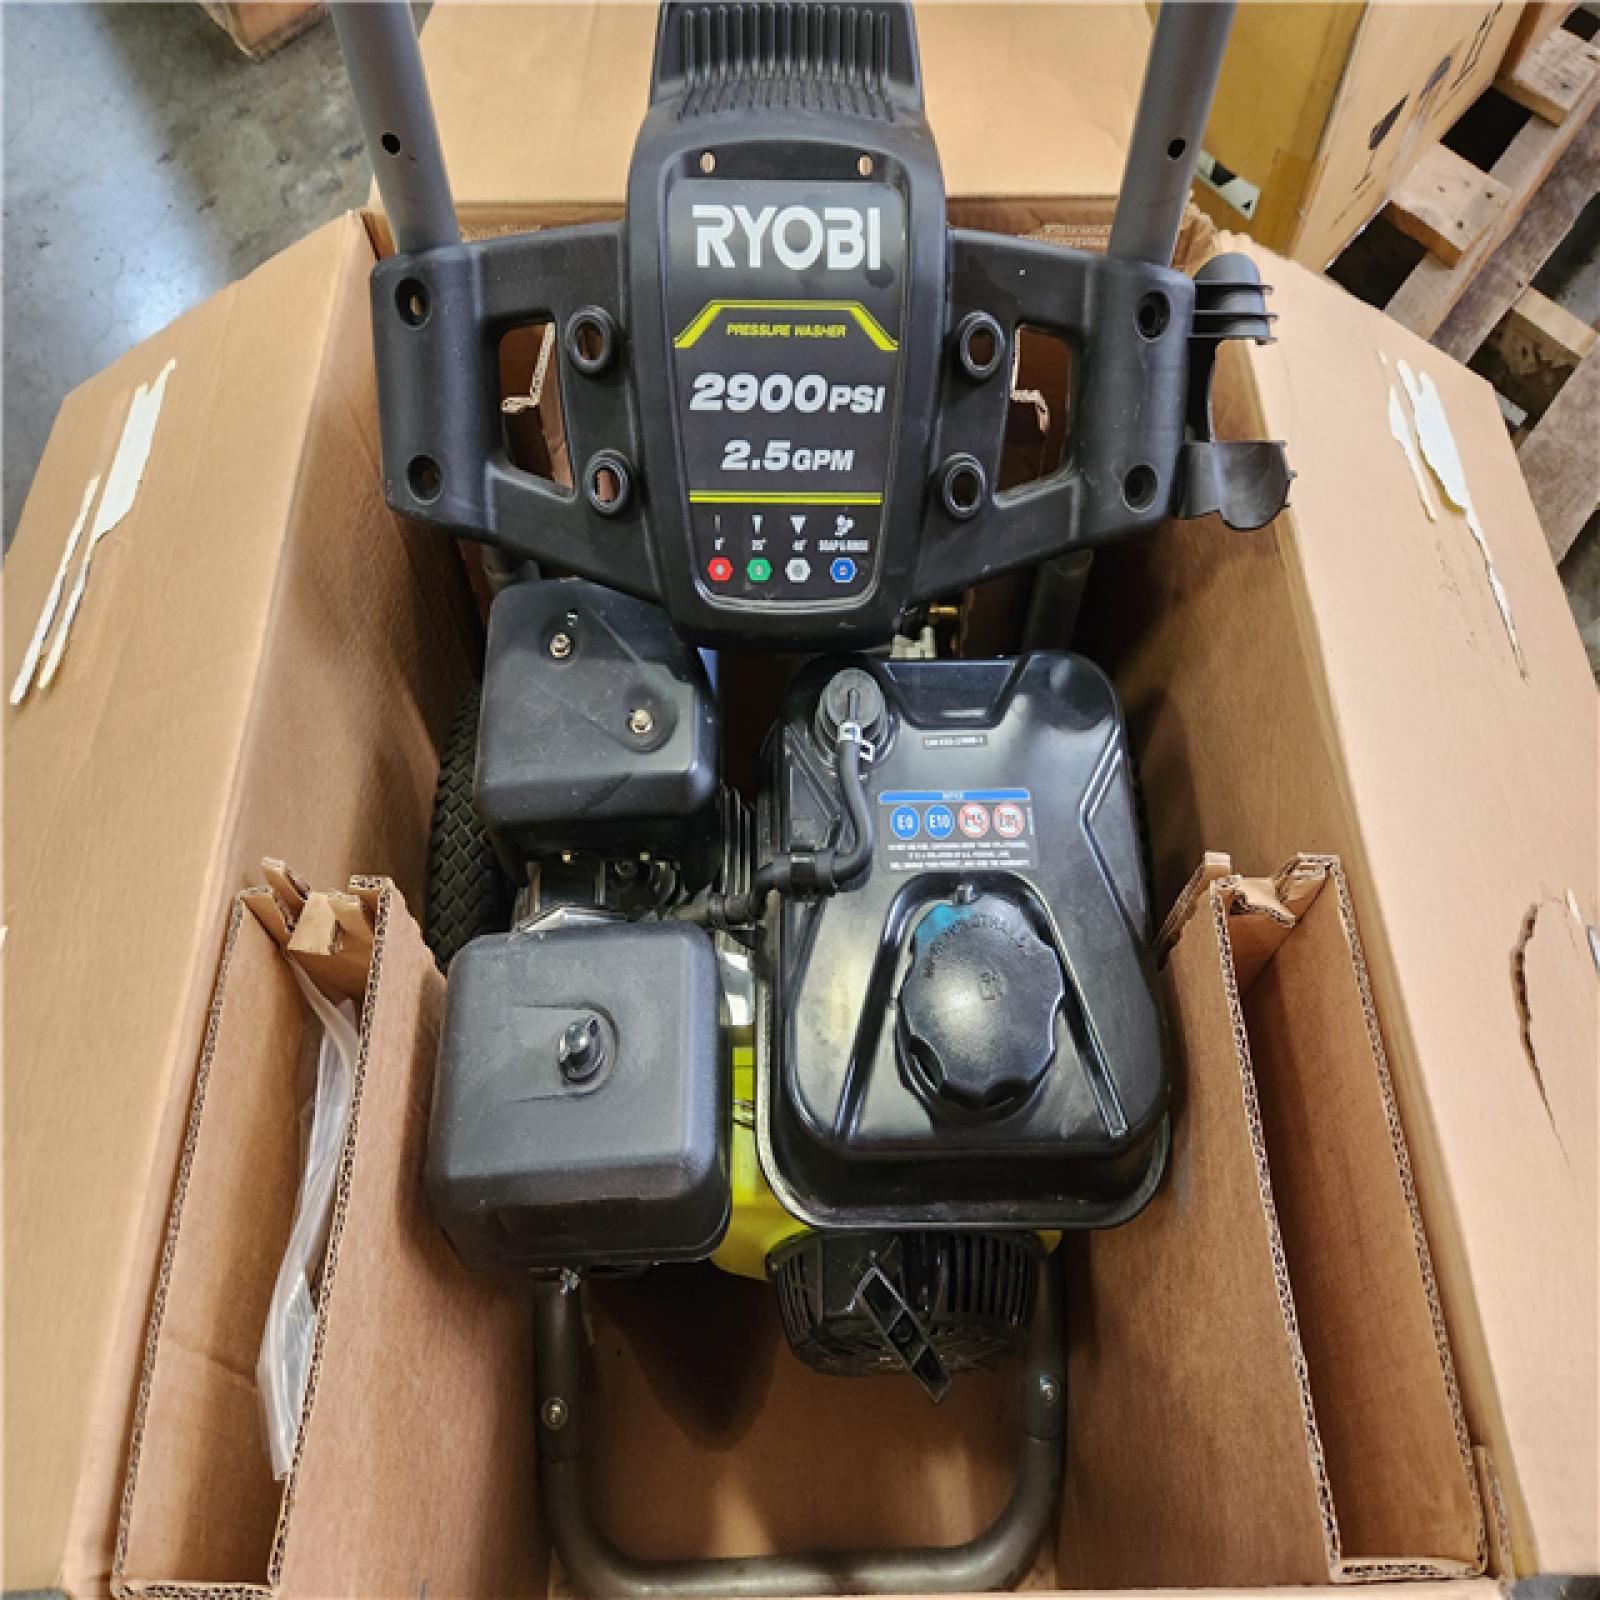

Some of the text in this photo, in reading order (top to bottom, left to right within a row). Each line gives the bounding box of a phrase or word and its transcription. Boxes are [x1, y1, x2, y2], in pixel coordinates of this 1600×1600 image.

[692, 204, 881, 271] RYOBI
[726, 323, 847, 338] PRESSURE WASHER
[689, 372, 886, 413] 2900PSI
[720, 439, 856, 471] 2.5GPM
